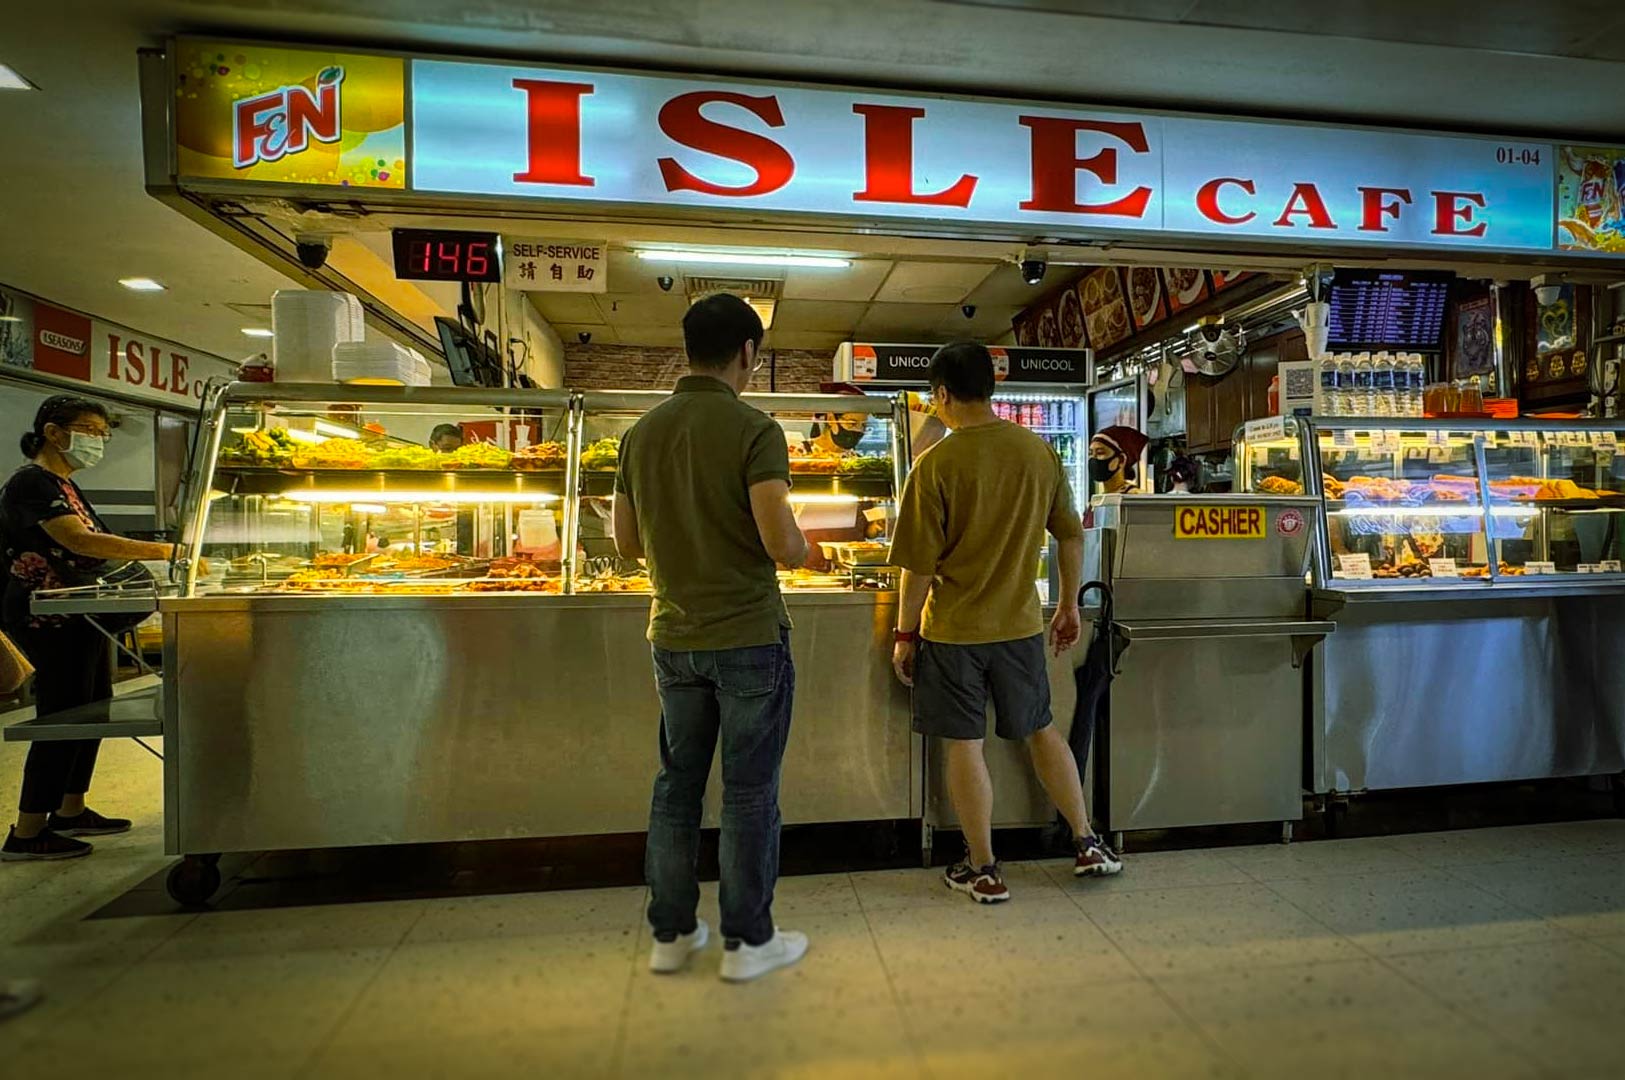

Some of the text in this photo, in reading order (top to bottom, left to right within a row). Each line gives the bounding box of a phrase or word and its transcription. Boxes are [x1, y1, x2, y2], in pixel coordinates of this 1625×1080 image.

[235, 83, 341, 164] F&N
[512, 78, 1488, 237] ISLE CAFE
[1496, 146, 1540, 165] 01-04
[423, 242, 488, 275] 146
[513, 243, 600, 260] SELF-SERVICE
[107, 333, 190, 396] ISLE
[889, 355, 931, 369] UNICO
[1020, 358, 1075, 371] UNICOOL
[1179, 507, 1261, 535] CASHIER
